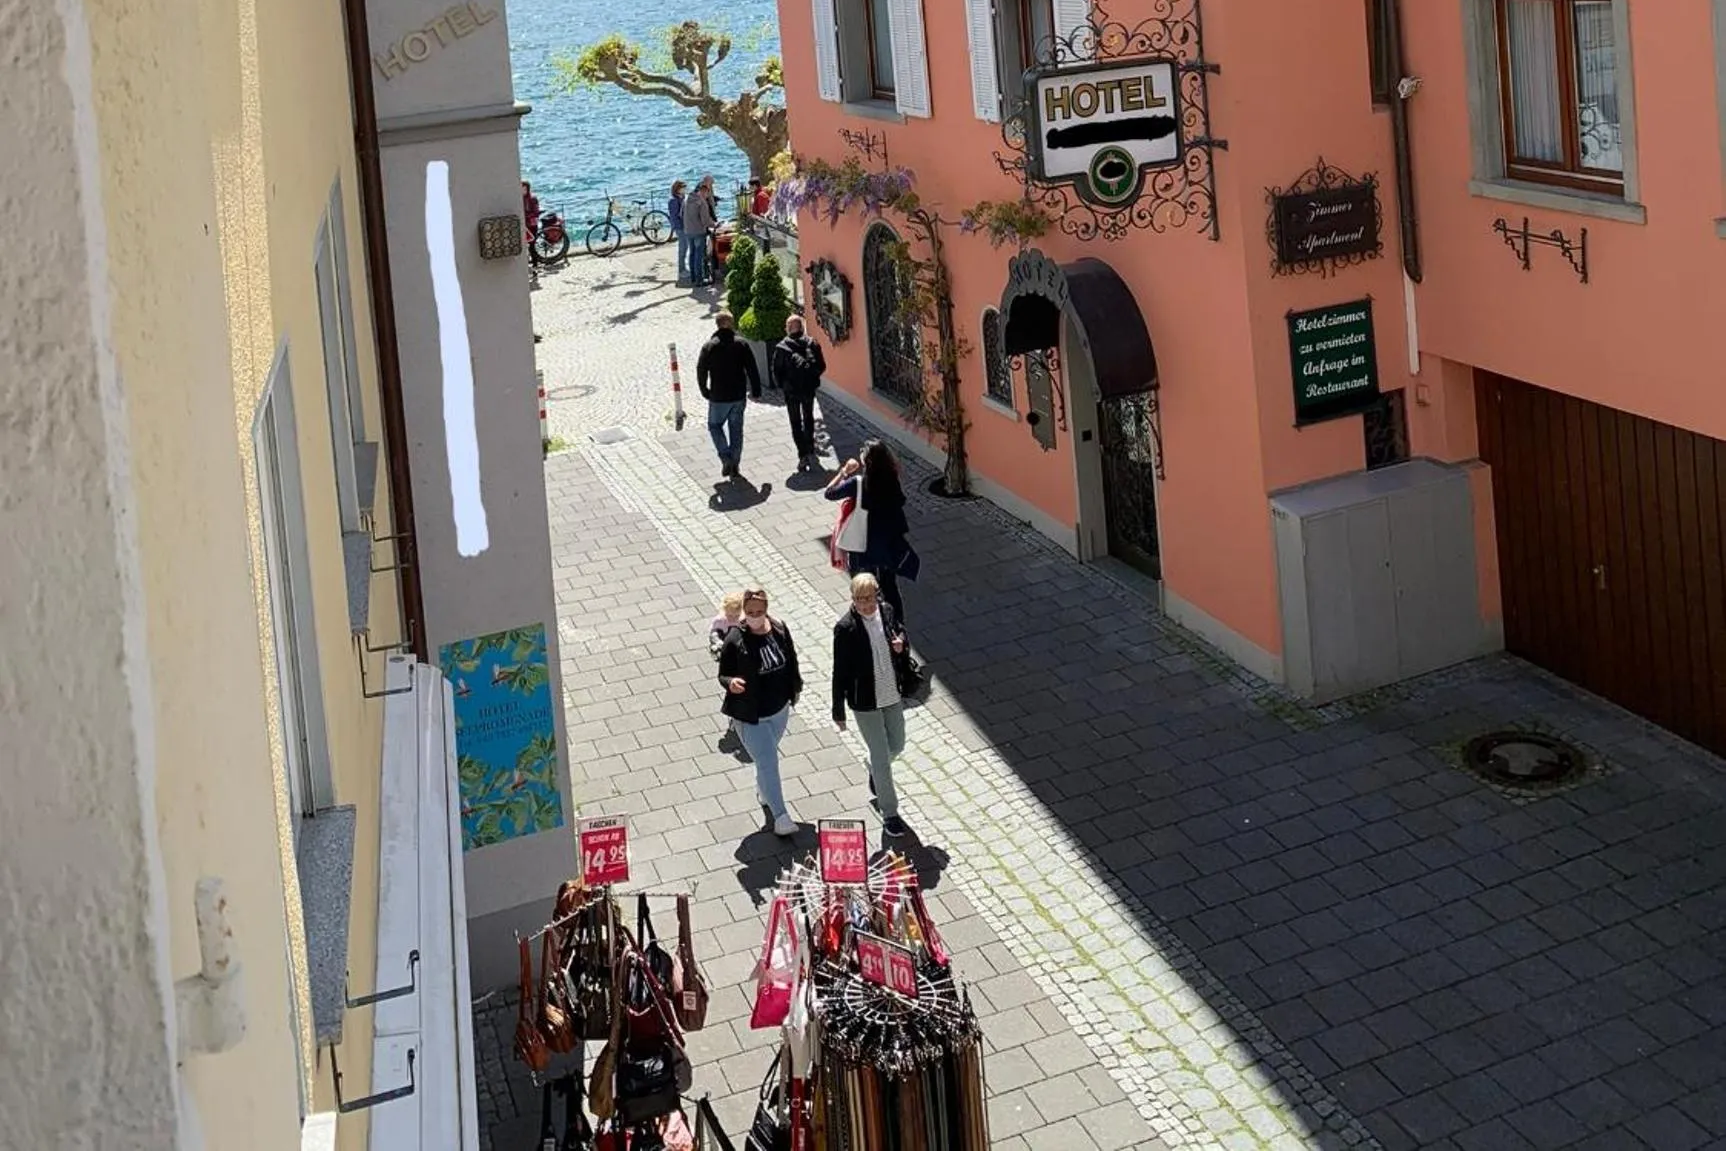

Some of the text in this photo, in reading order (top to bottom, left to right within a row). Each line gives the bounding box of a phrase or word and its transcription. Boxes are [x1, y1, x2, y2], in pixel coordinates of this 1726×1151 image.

[1045, 75, 1167, 122] HOTEL
[1306, 201, 1353, 223] Zimmer
[1297, 226, 1365, 254] Apartment
[1295, 310, 1367, 333] Hotelzimmer
[1299, 333, 1367, 355] zu vermieten
[1302, 352, 1366, 377] Anfrage im
[1305, 374, 1369, 398] Restaurant
